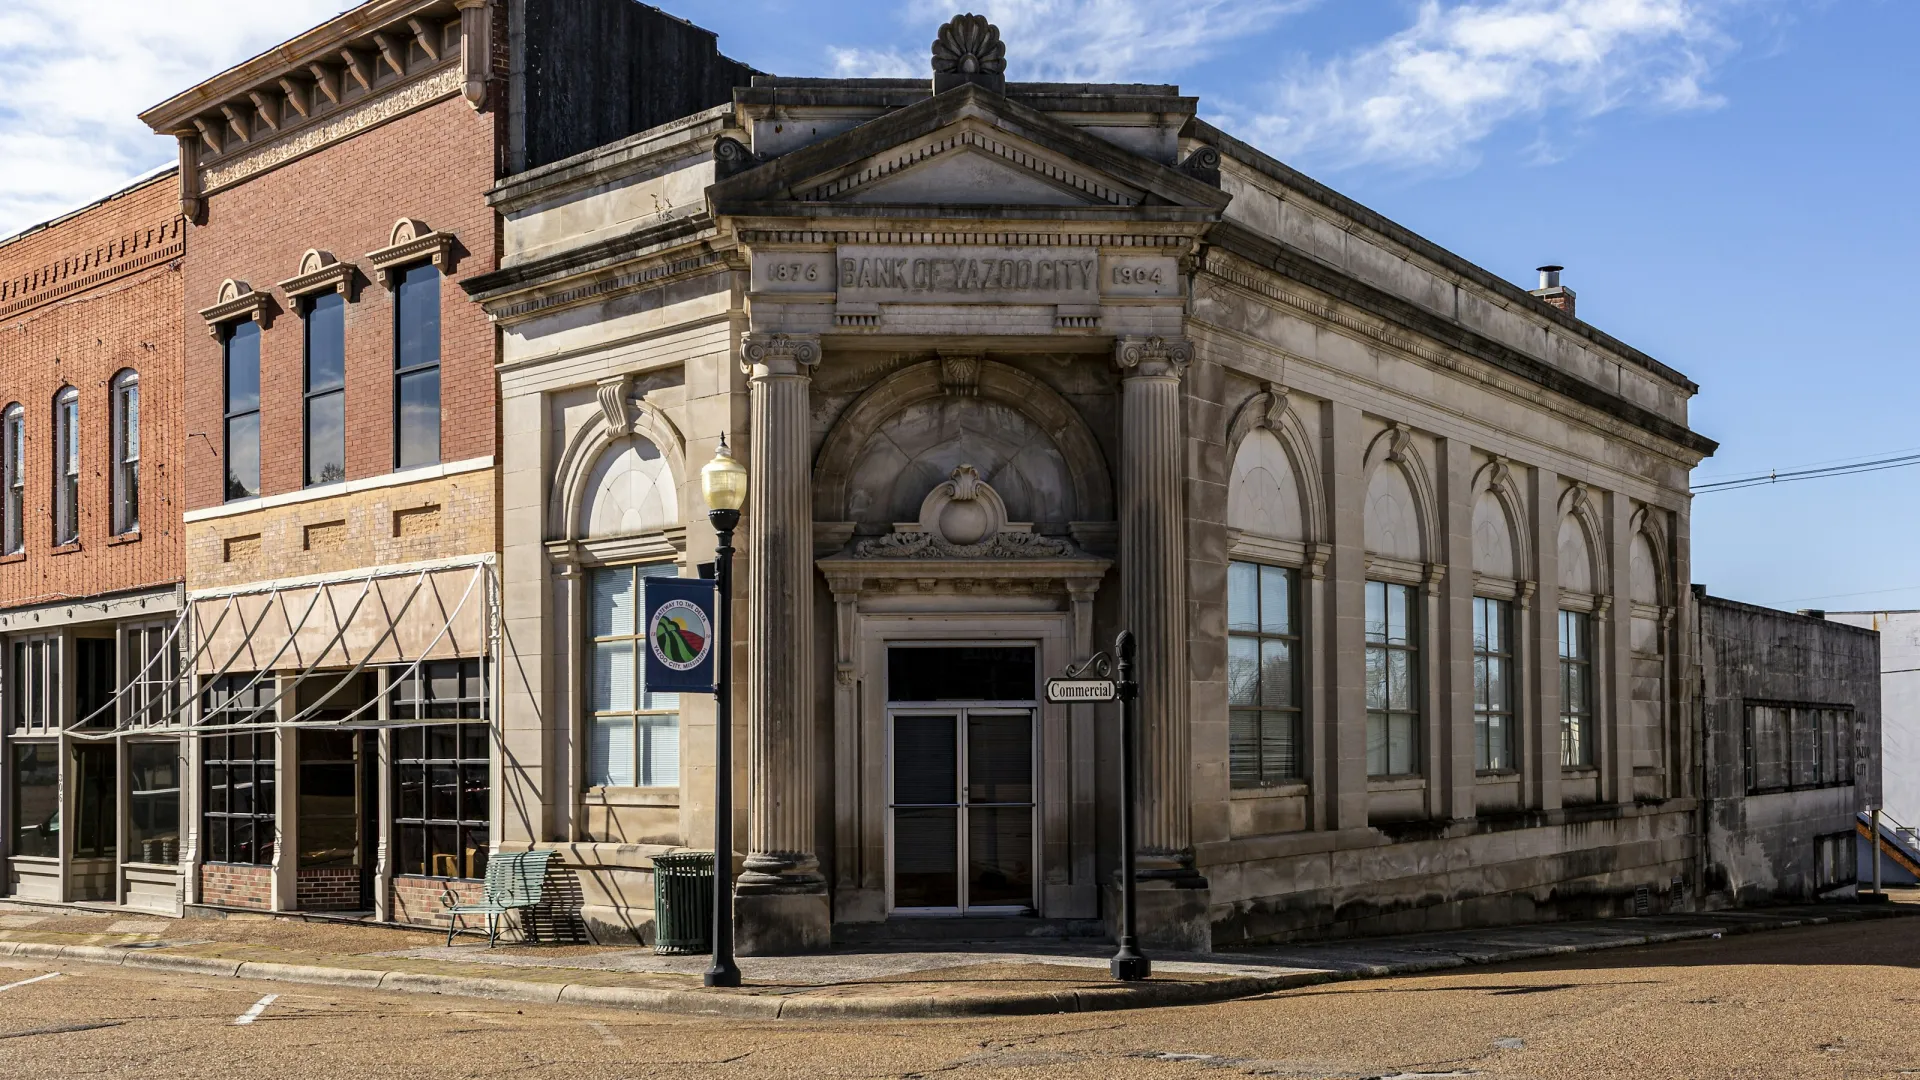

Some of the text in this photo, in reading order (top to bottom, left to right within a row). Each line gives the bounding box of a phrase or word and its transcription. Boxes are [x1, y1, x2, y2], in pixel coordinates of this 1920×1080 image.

[767, 263, 818, 282] 1876
[840, 257, 1094, 291] BANK OF YAZOO CITY
[1112, 267, 1162, 285] 1904
[655, 602, 675, 620] GATEWAY
[694, 607, 707, 622] DELTA
[654, 645, 667, 663] YAZOO
[683, 648, 707, 668] MISSISSIPPI
[1051, 682, 1112, 698] Commercial
